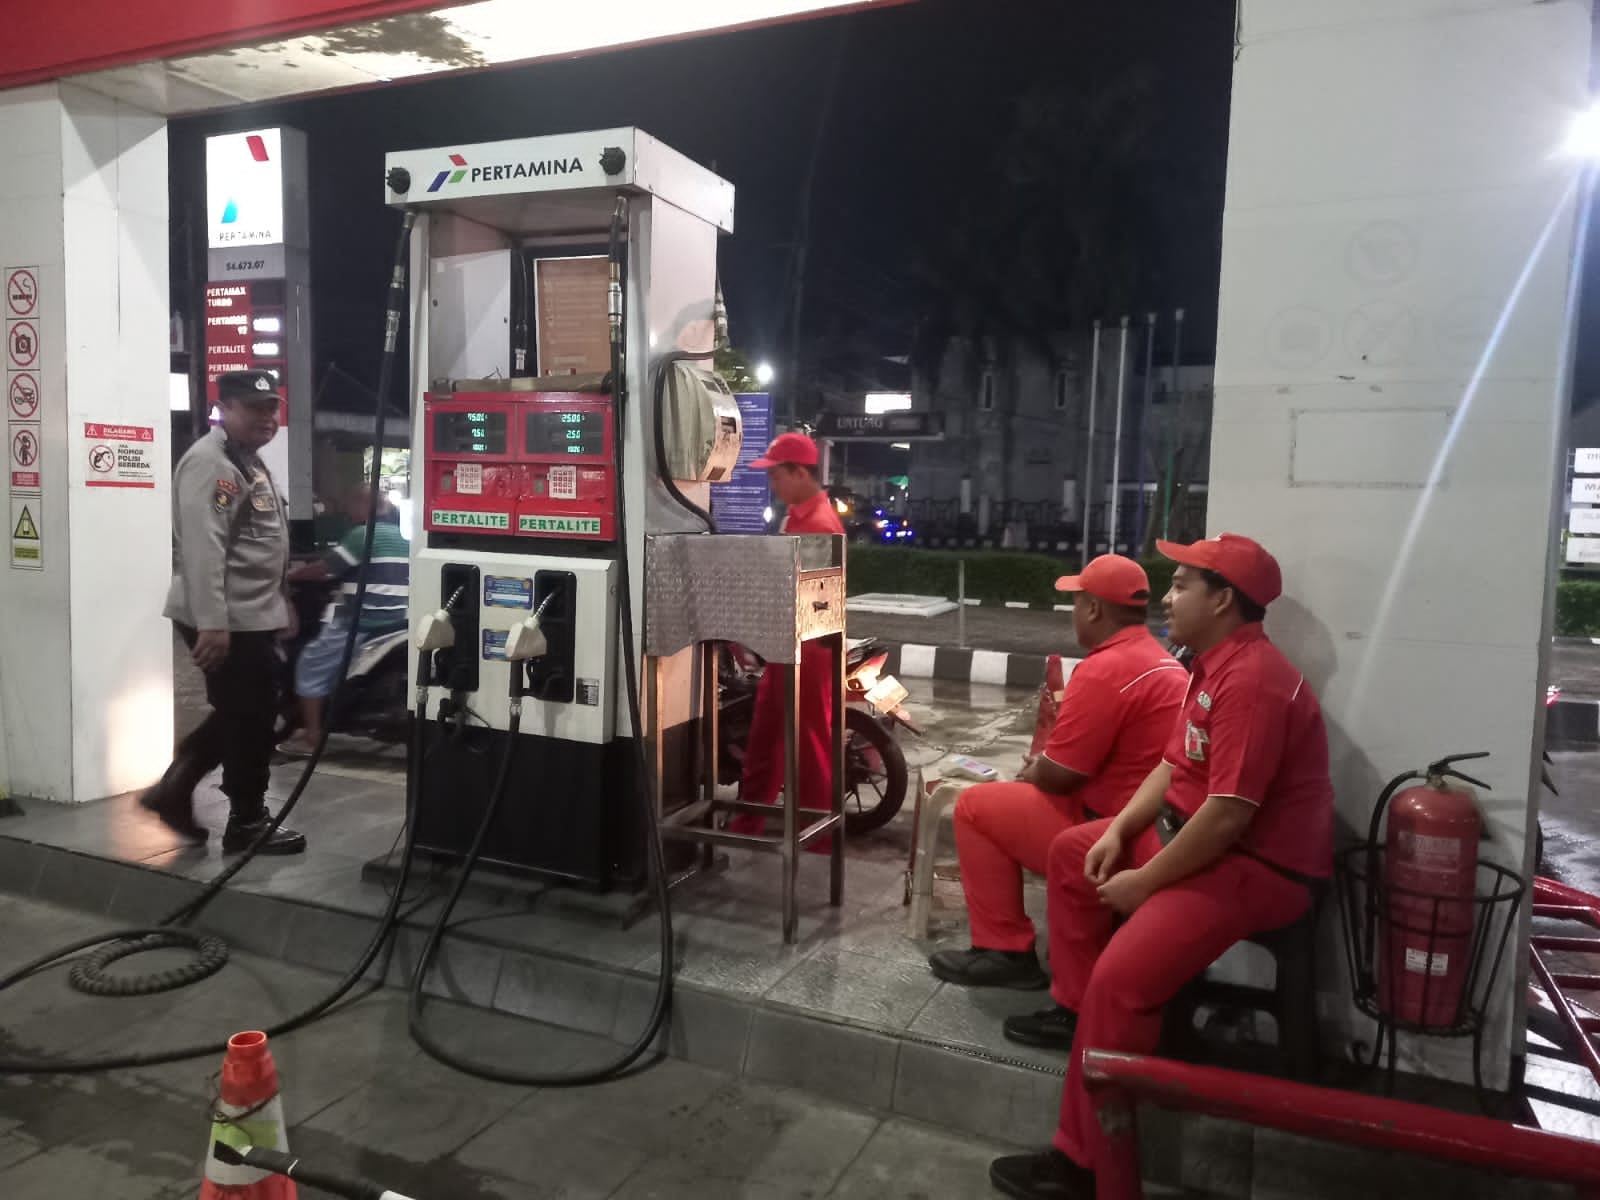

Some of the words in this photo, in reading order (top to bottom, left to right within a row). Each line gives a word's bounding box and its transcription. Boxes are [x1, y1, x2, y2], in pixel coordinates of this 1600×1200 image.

[471, 157, 584, 183] PERTAMINA
[219, 229, 272, 241] PERTAMINA
[207, 287, 246, 296] PERTAMAX
[208, 297, 232, 307] TURBO
[208, 344, 246, 353] PERTALITE
[208, 363, 248, 372] PERTAMINA
[432, 512, 508, 527] PERTALITE
[519, 518, 600, 532] PERTALITE
